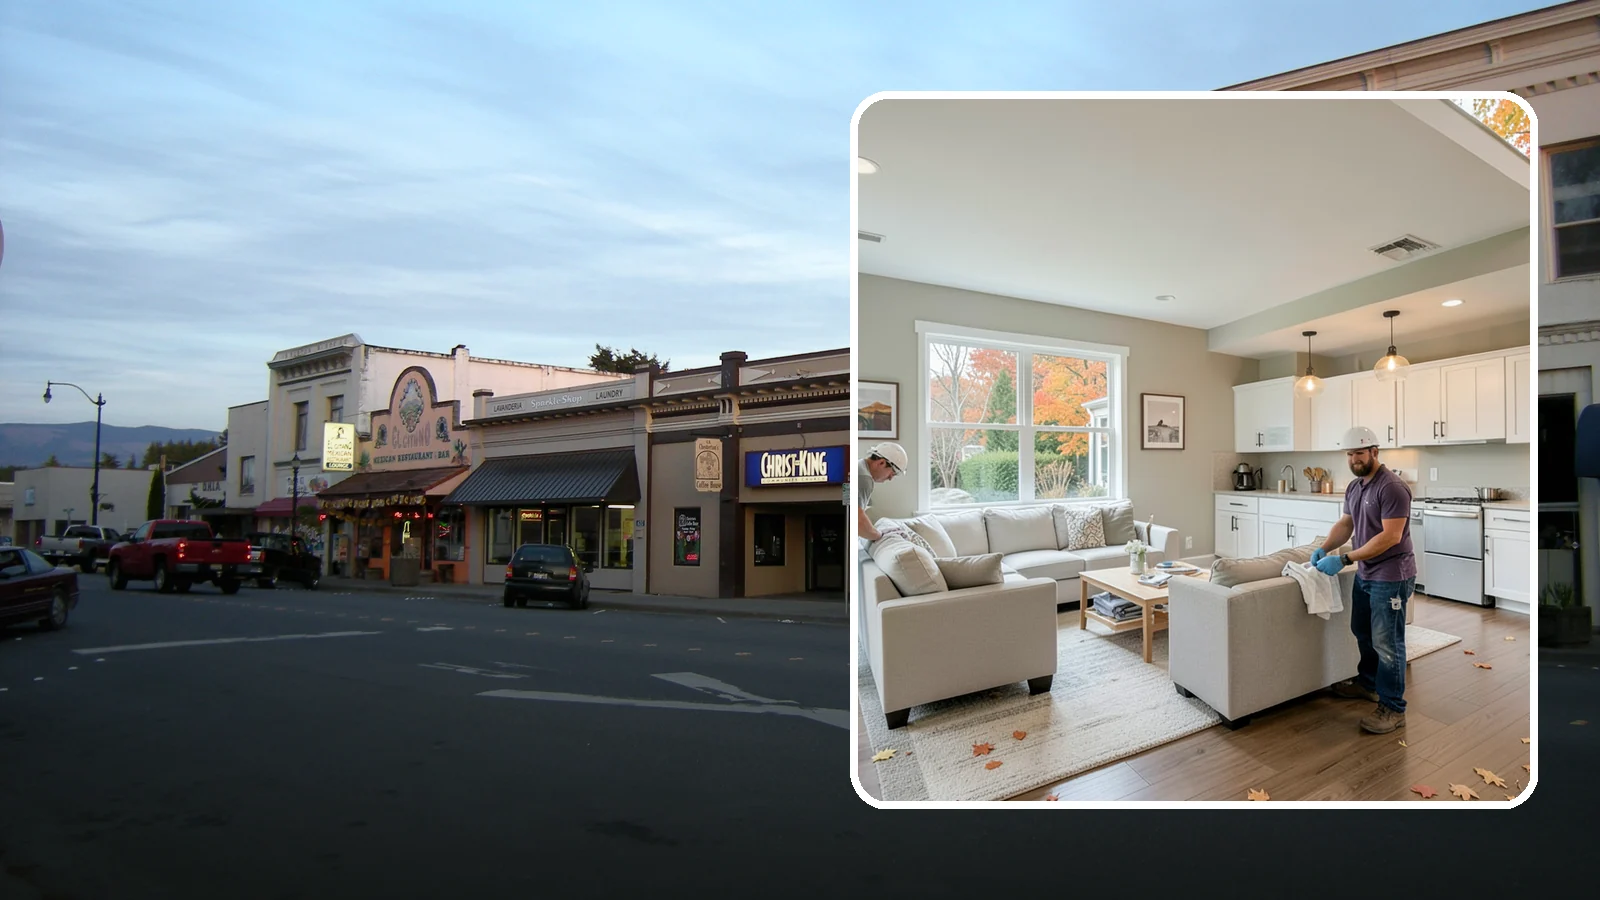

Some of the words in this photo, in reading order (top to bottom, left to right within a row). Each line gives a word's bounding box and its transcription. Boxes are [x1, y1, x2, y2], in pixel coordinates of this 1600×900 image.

[493, 401, 523, 413] LAVANDERIA
[561, 394, 583, 405] Shop
[595, 389, 624, 400] LAUNDRY
[397, 451, 433, 462] RESTAURANT
[437, 450, 450, 458] BAR
[799, 450, 827, 477] KING
